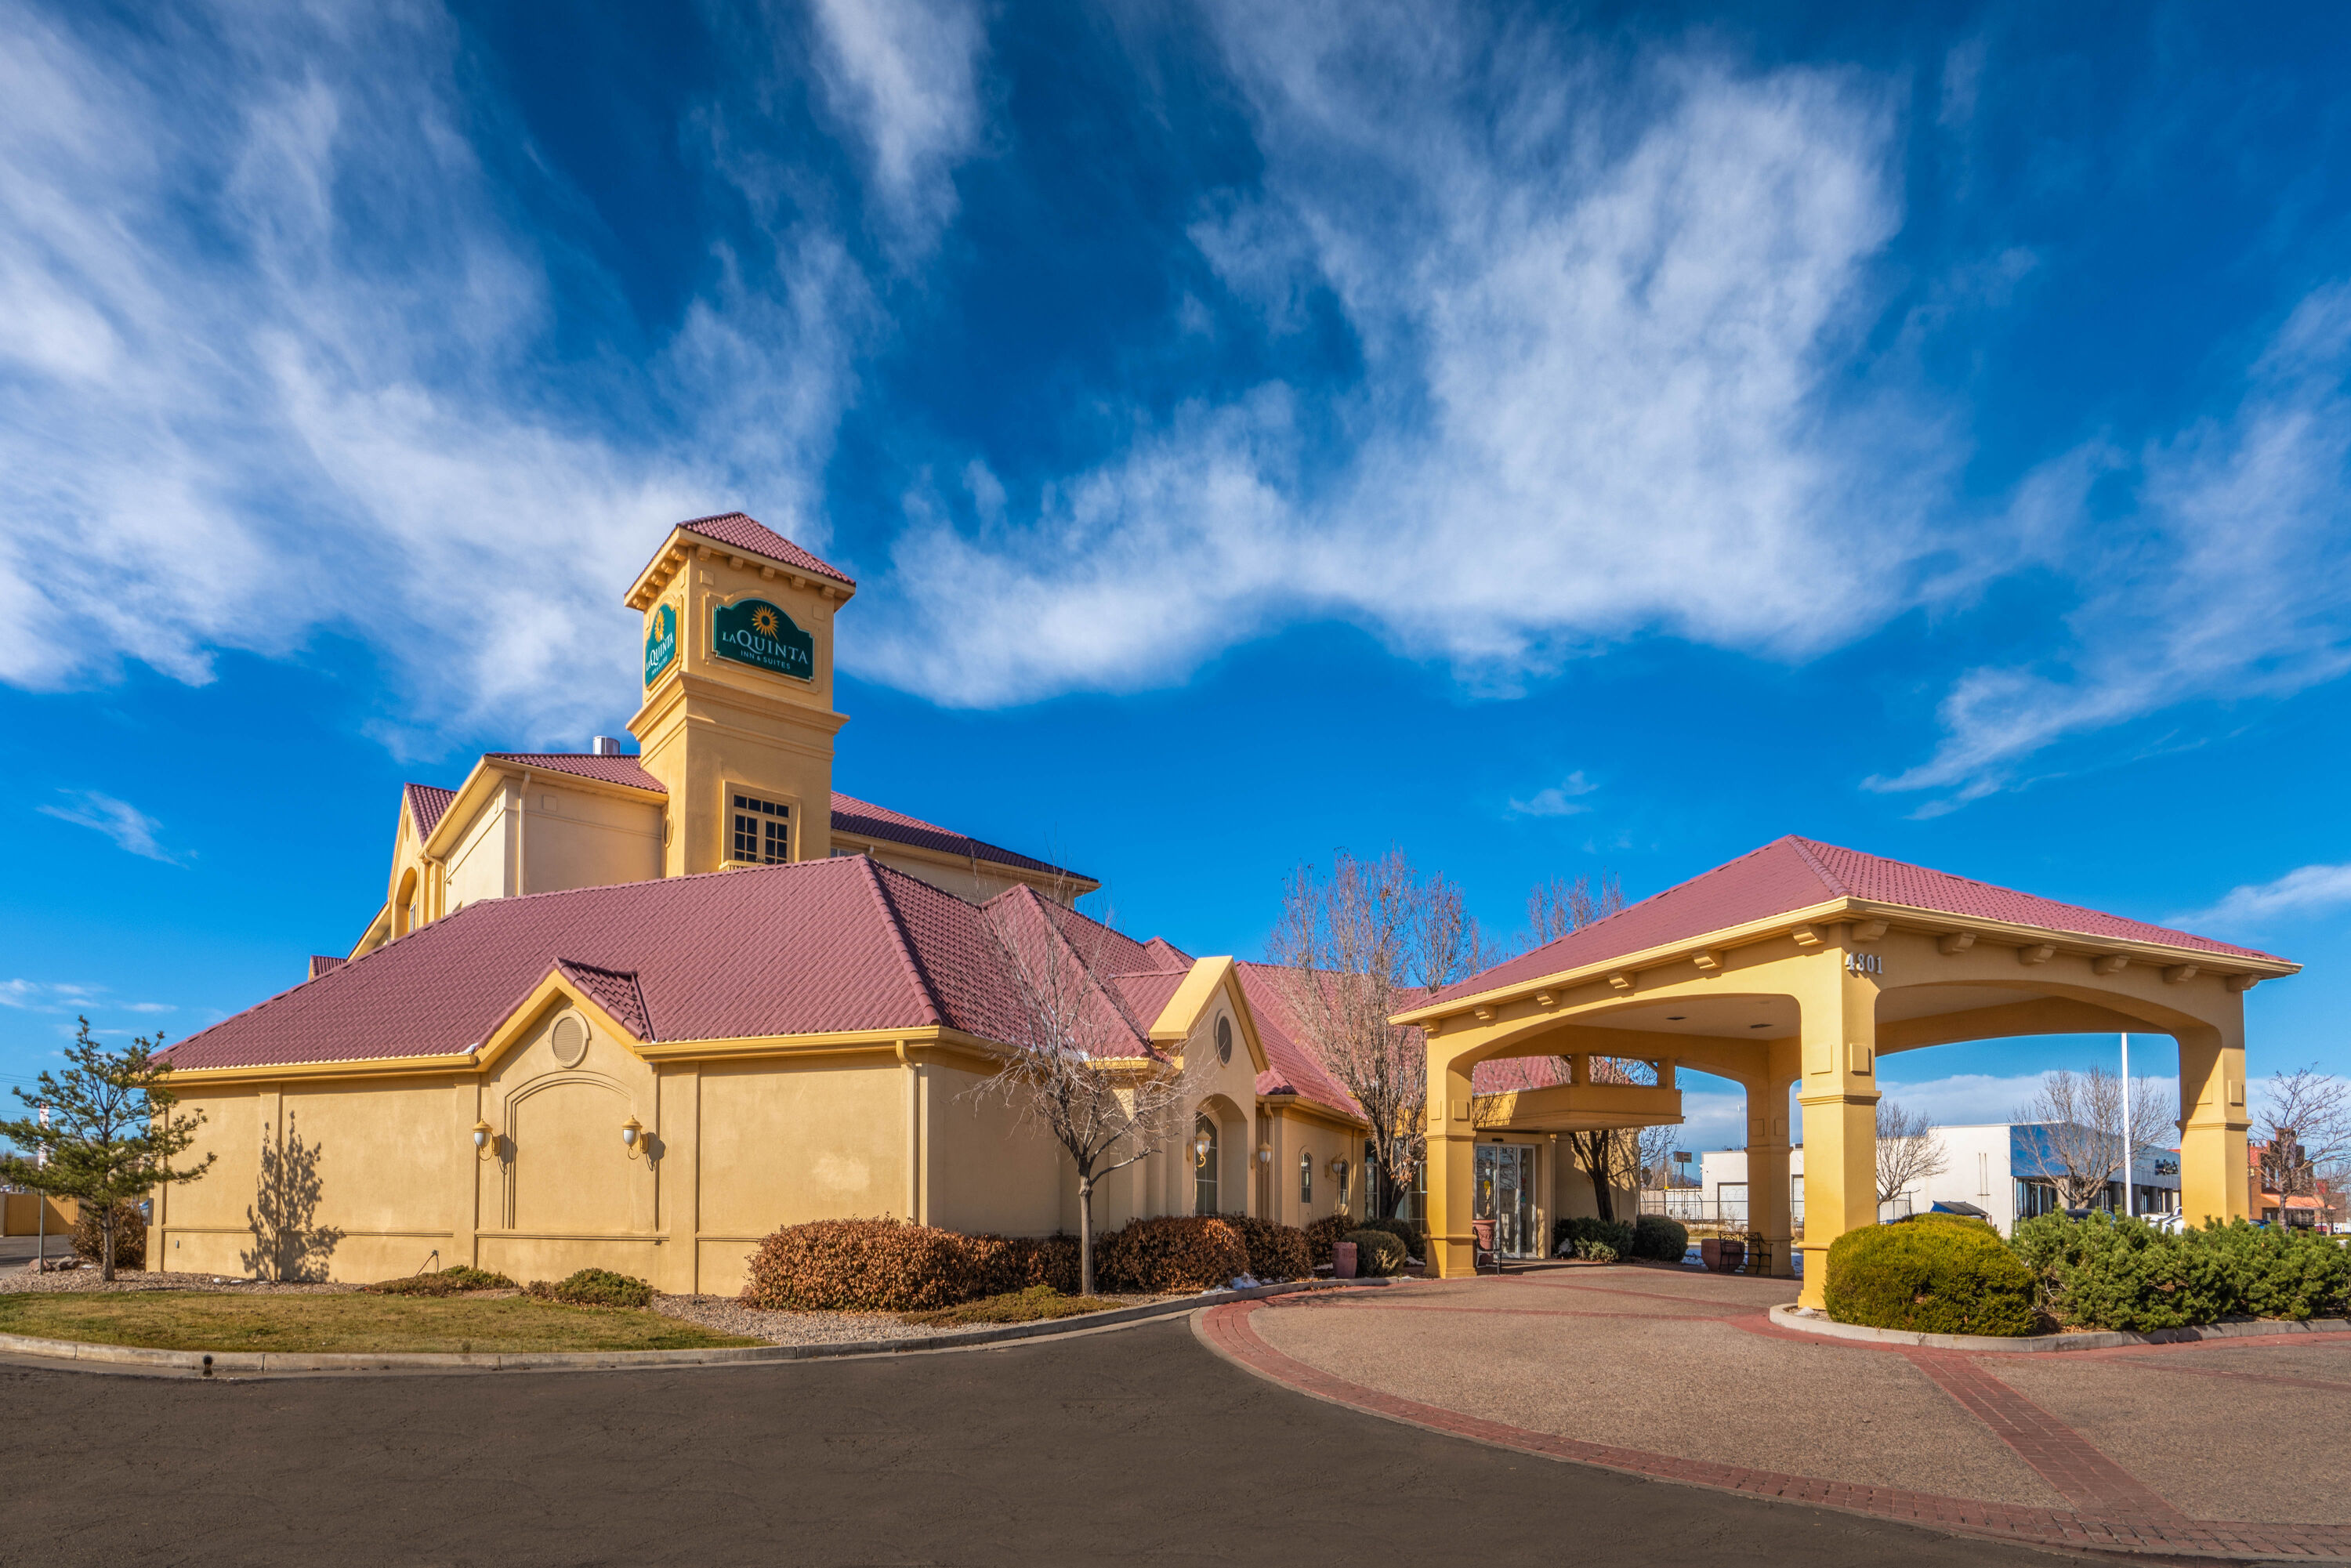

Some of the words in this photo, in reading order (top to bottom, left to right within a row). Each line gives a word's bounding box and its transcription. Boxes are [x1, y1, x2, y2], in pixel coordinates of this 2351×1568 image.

[741, 650, 755, 659] INN
[763, 657, 791, 670] SUITES
[1845, 952, 1883, 974] 4801
